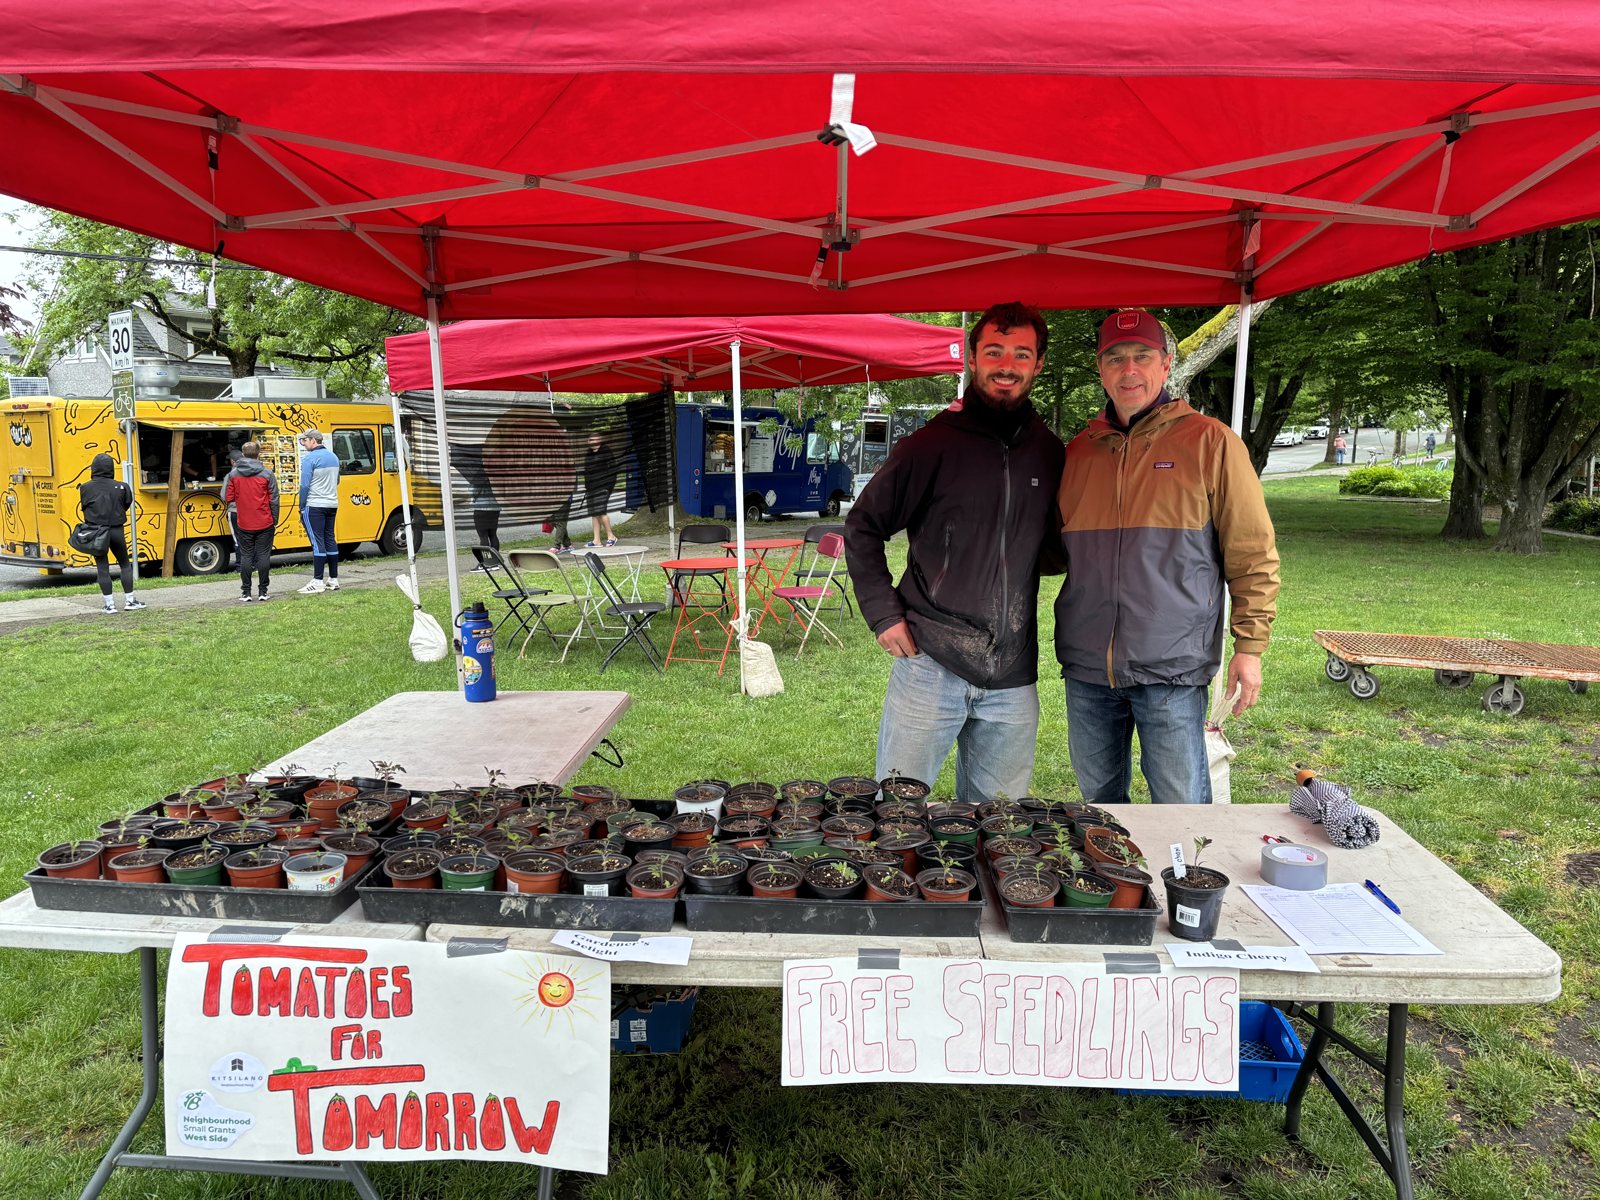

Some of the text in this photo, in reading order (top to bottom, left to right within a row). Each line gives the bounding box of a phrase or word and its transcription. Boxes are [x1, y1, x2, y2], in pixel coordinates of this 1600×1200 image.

[112, 327, 130, 354] 30
[114, 358, 130, 367] km/h
[574, 934, 650, 947] Gardener's
[570, 940, 618, 956] Delight
[1186, 951, 1288, 962] Indigo Cherry
[181, 943, 414, 1019] TOMATOES
[786, 961, 1238, 1086] FREE SEEDLINGS
[331, 1024, 383, 1061] FOR
[268, 1063, 561, 1156] TOMORROW
[183, 1115, 251, 1125] Neighbourhood
[208, 1125, 237, 1134] Grants
[184, 1133, 228, 1142] West Side
